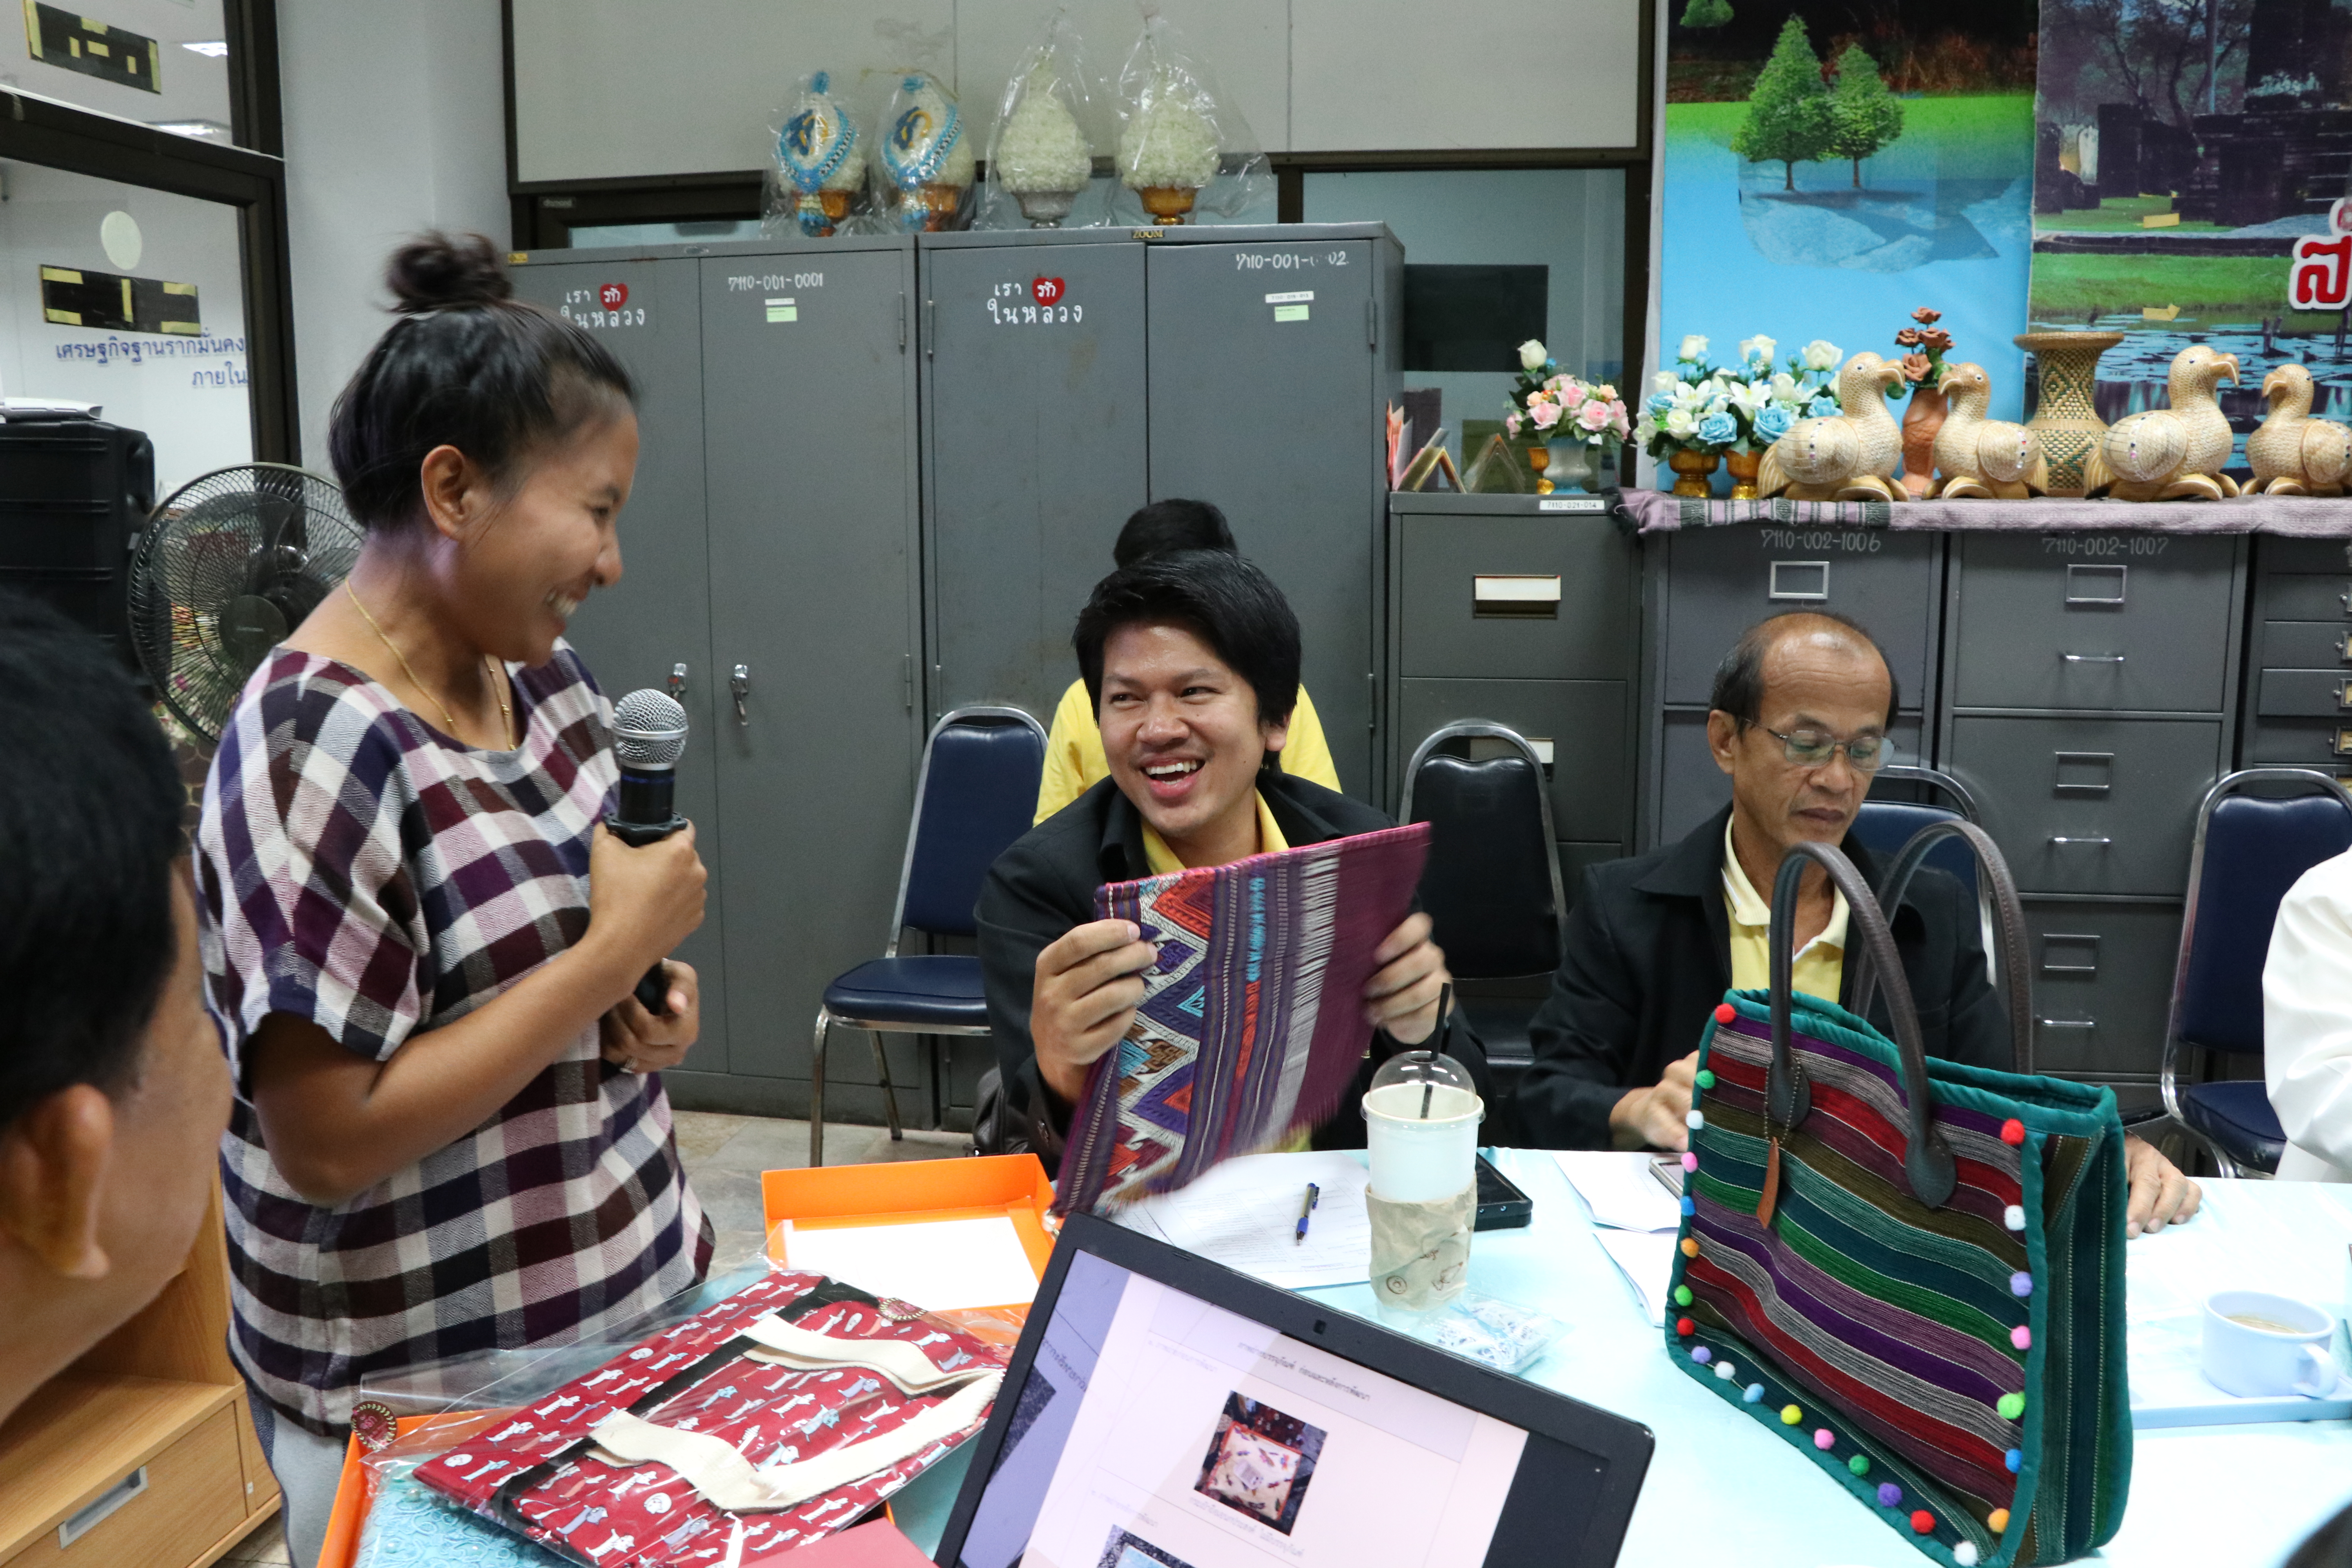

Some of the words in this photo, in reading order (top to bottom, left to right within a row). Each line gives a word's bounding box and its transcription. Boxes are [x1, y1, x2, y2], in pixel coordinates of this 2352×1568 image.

[1132, 229, 1163, 238] ZOOM
[728, 272, 824, 291] 7110-001-0001
[994, 282, 1022, 297] เรา
[1037, 281, 1057, 298] รัก
[566, 289, 591, 304] เรา
[603, 287, 621, 303] รัก
[987, 298, 1083, 325] ในหลวง
[55, 326, 245, 364] เศรษฐกิจฐานรากมั่นคง
[1760, 528, 1882, 552] 7110-002-1006
[2041, 535, 2170, 555] 7110-002-1007
